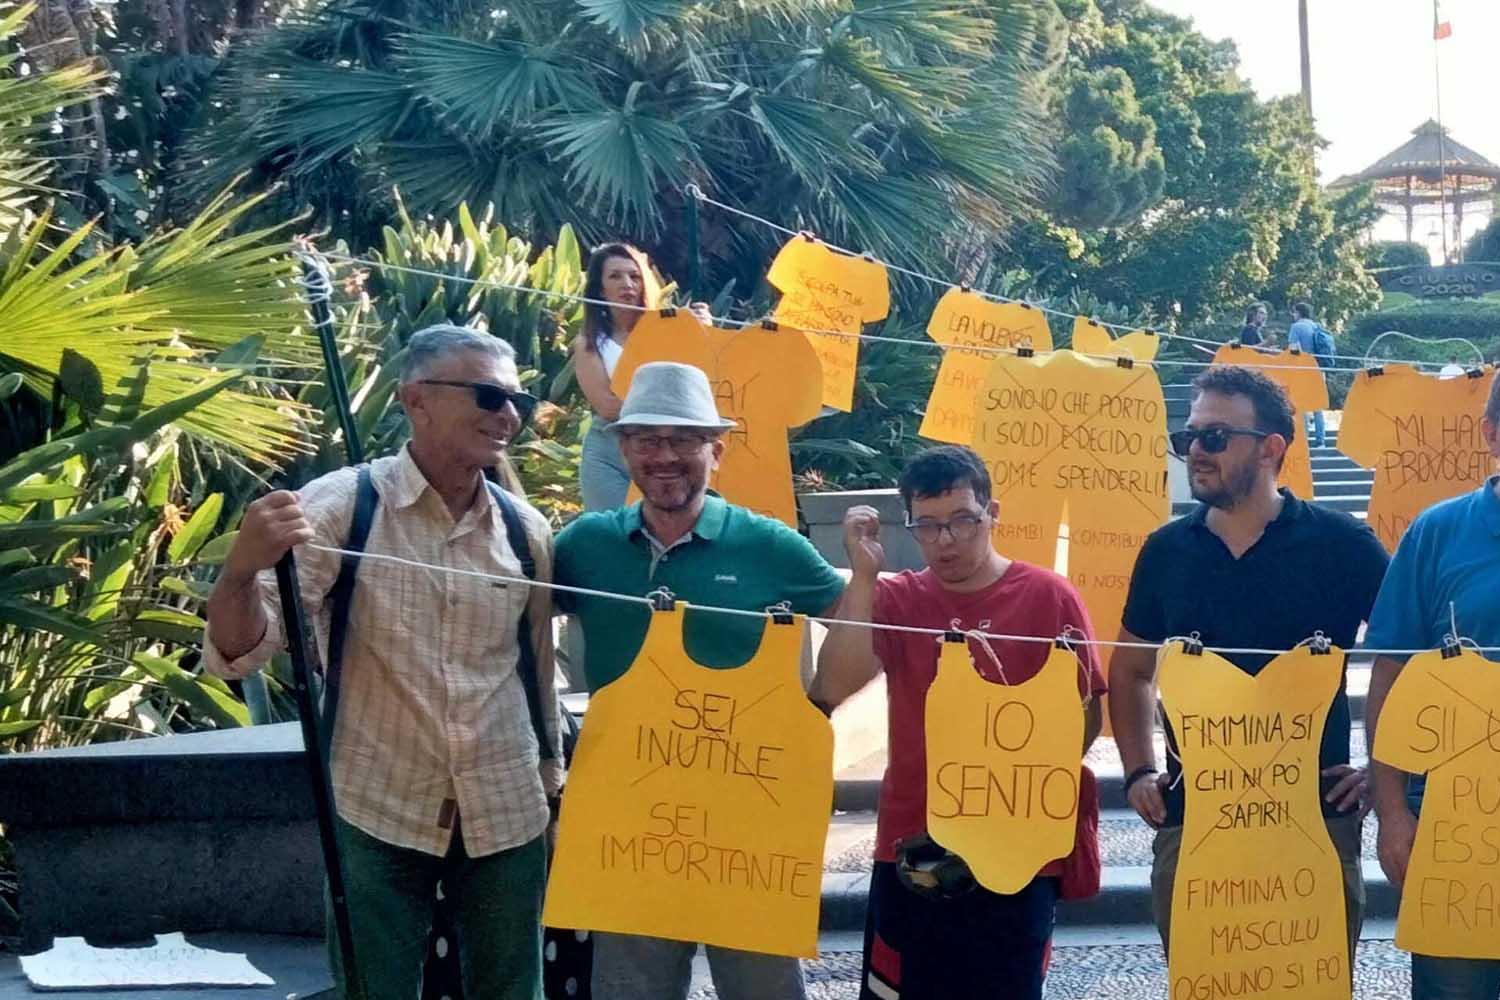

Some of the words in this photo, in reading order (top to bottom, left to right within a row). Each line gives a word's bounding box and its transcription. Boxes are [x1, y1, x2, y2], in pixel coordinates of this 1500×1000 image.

[985, 388, 1036, 412] SONO
[1062, 391, 1092, 416] CHE
[1100, 394, 1159, 424] PORTO
[996, 420, 1050, 449] SOLDI
[1076, 425, 1143, 456] DECIDO
[1150, 435, 1169, 460] IO
[671, 689, 738, 735] SEI
[984, 700, 1034, 752] IO
[1181, 712, 1285, 748] FIMMINA
[1290, 713, 1314, 741] SI
[1410, 704, 1457, 754] SII
[636, 725, 785, 781] INUTILE
[930, 762, 1077, 821] SENTO
[1195, 767, 1234, 792] CHI
[646, 802, 709, 838] SEI
[601, 834, 815, 898] IMPORTANTE
[1187, 875, 1287, 911] FIMMINA
[1294, 867, 1315, 897] O
[1210, 916, 1321, 957] MASCULU
[1283, 962, 1305, 990] SI
